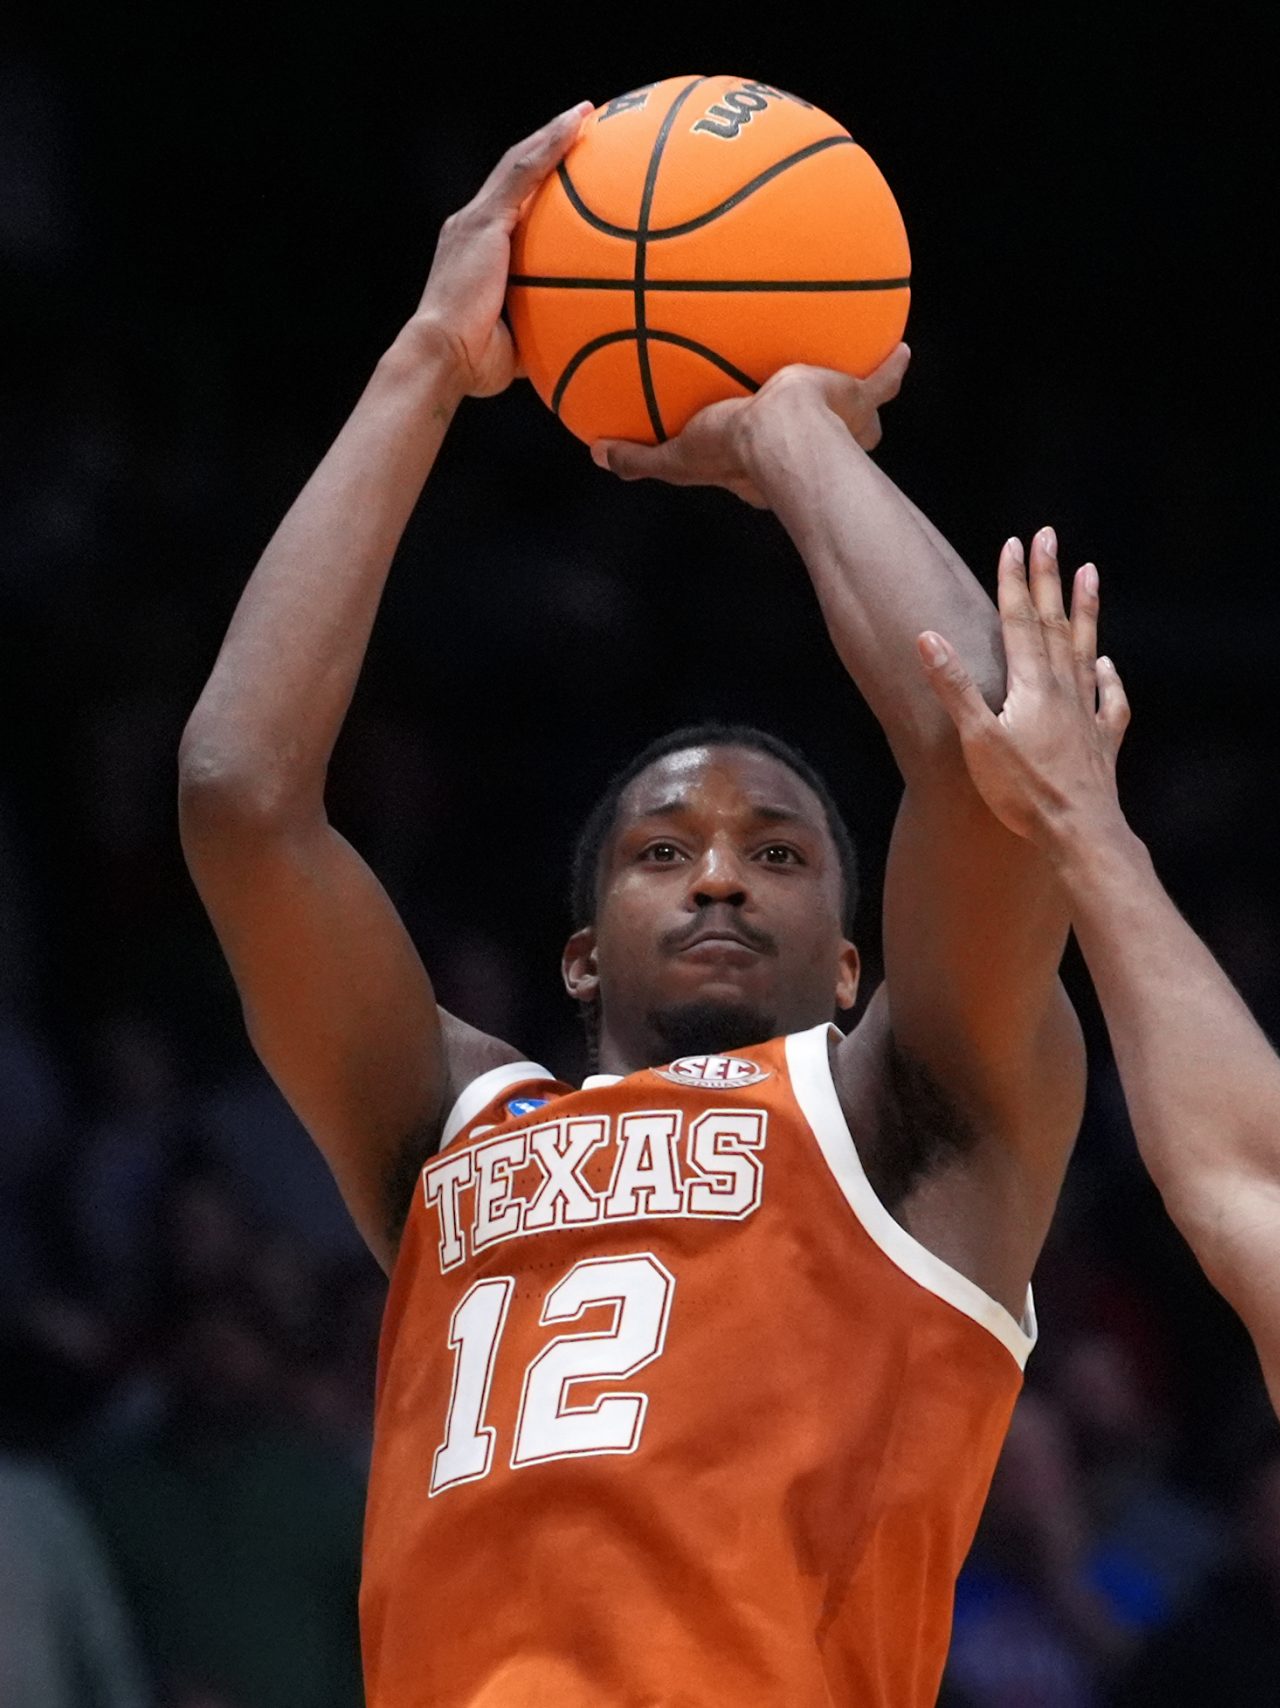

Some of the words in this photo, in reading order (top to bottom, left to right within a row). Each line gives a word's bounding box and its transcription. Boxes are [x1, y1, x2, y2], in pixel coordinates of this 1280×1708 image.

[673, 1057, 755, 1080] SEC
[422, 1108, 769, 1275] TEXAS
[428, 1252, 676, 1498] 12
